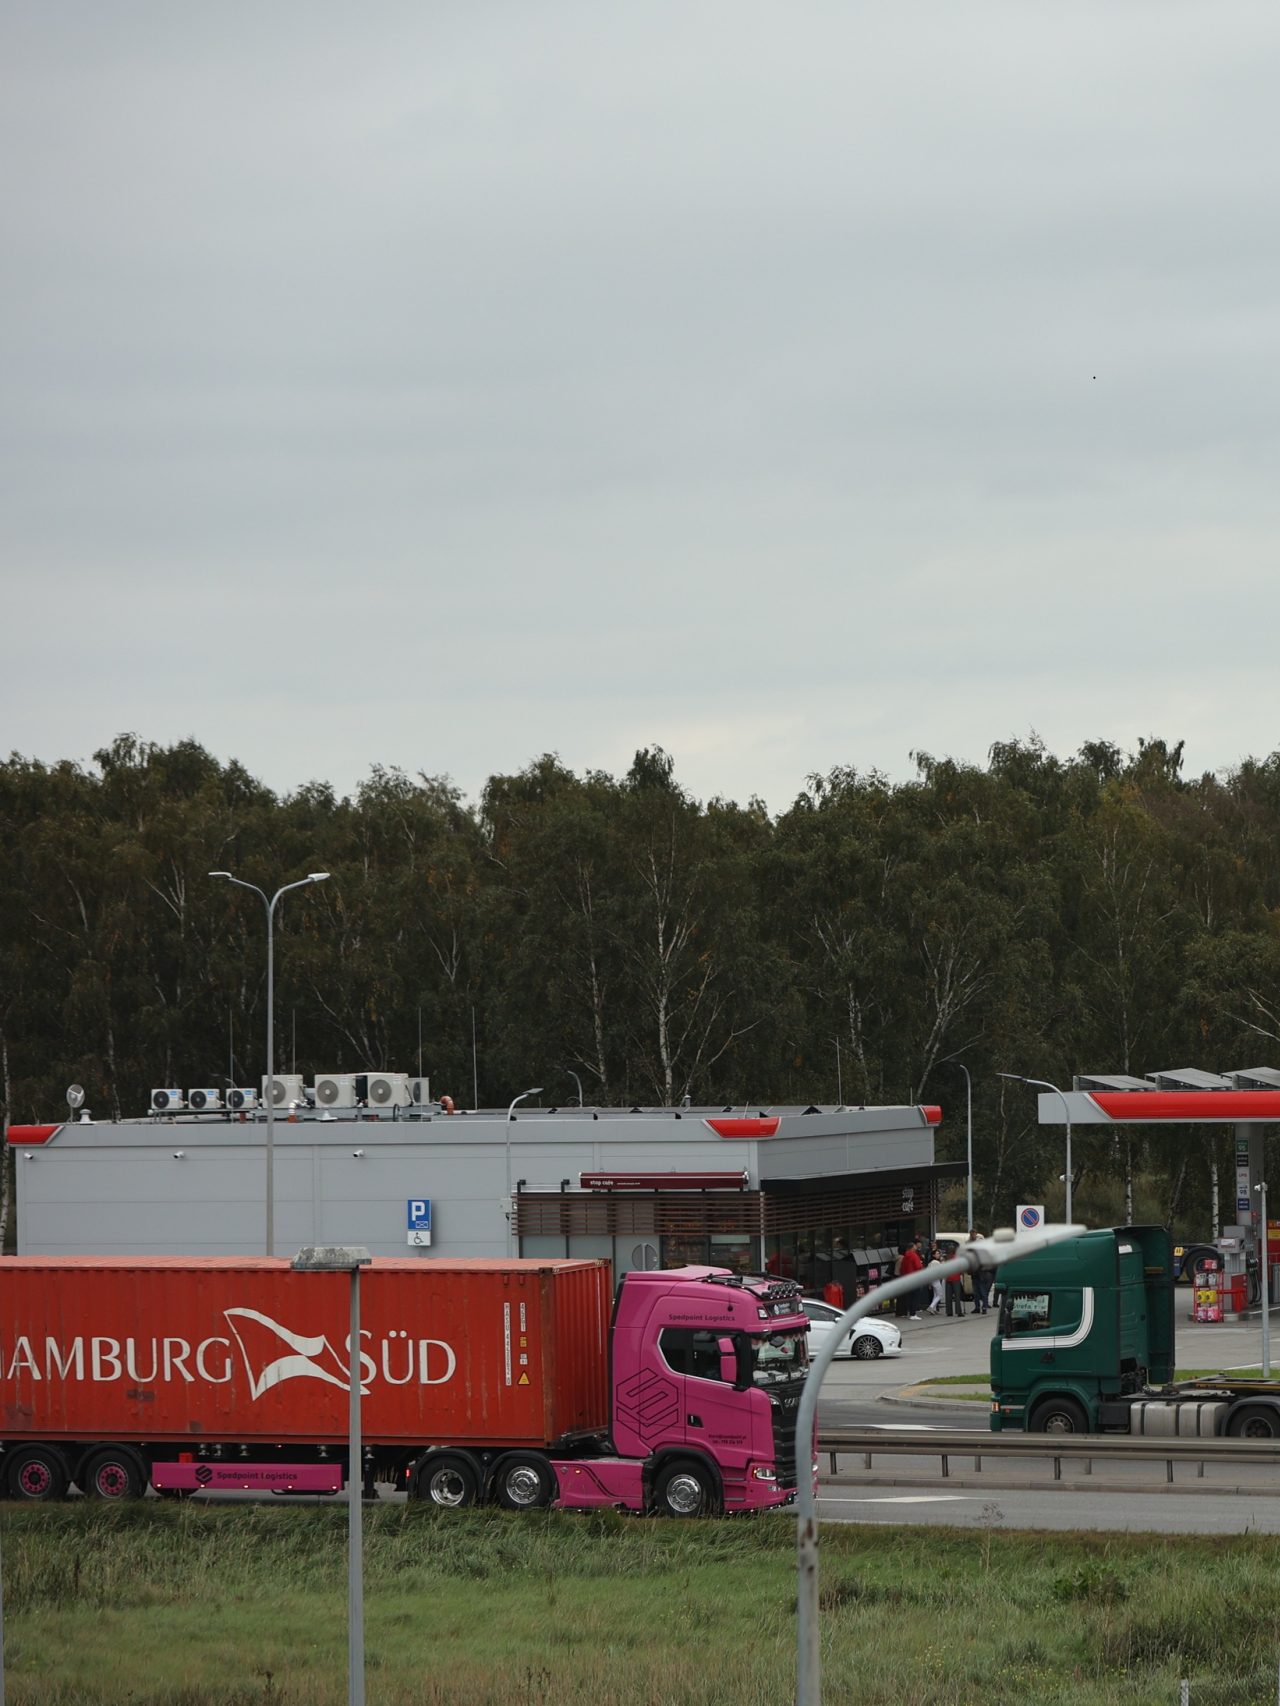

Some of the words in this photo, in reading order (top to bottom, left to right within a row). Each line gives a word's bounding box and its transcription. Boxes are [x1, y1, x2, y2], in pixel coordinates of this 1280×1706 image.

[412, 1202, 425, 1221] P
[668, 1313, 702, 1321] Spedpoint
[704, 1314, 736, 1322] Logistics
[0, 1336, 232, 1383] AMBURG
[345, 1329, 457, 1385] SÜD
[217, 1471, 258, 1480] Spedpoint
[260, 1472, 298, 1481] Logistics
